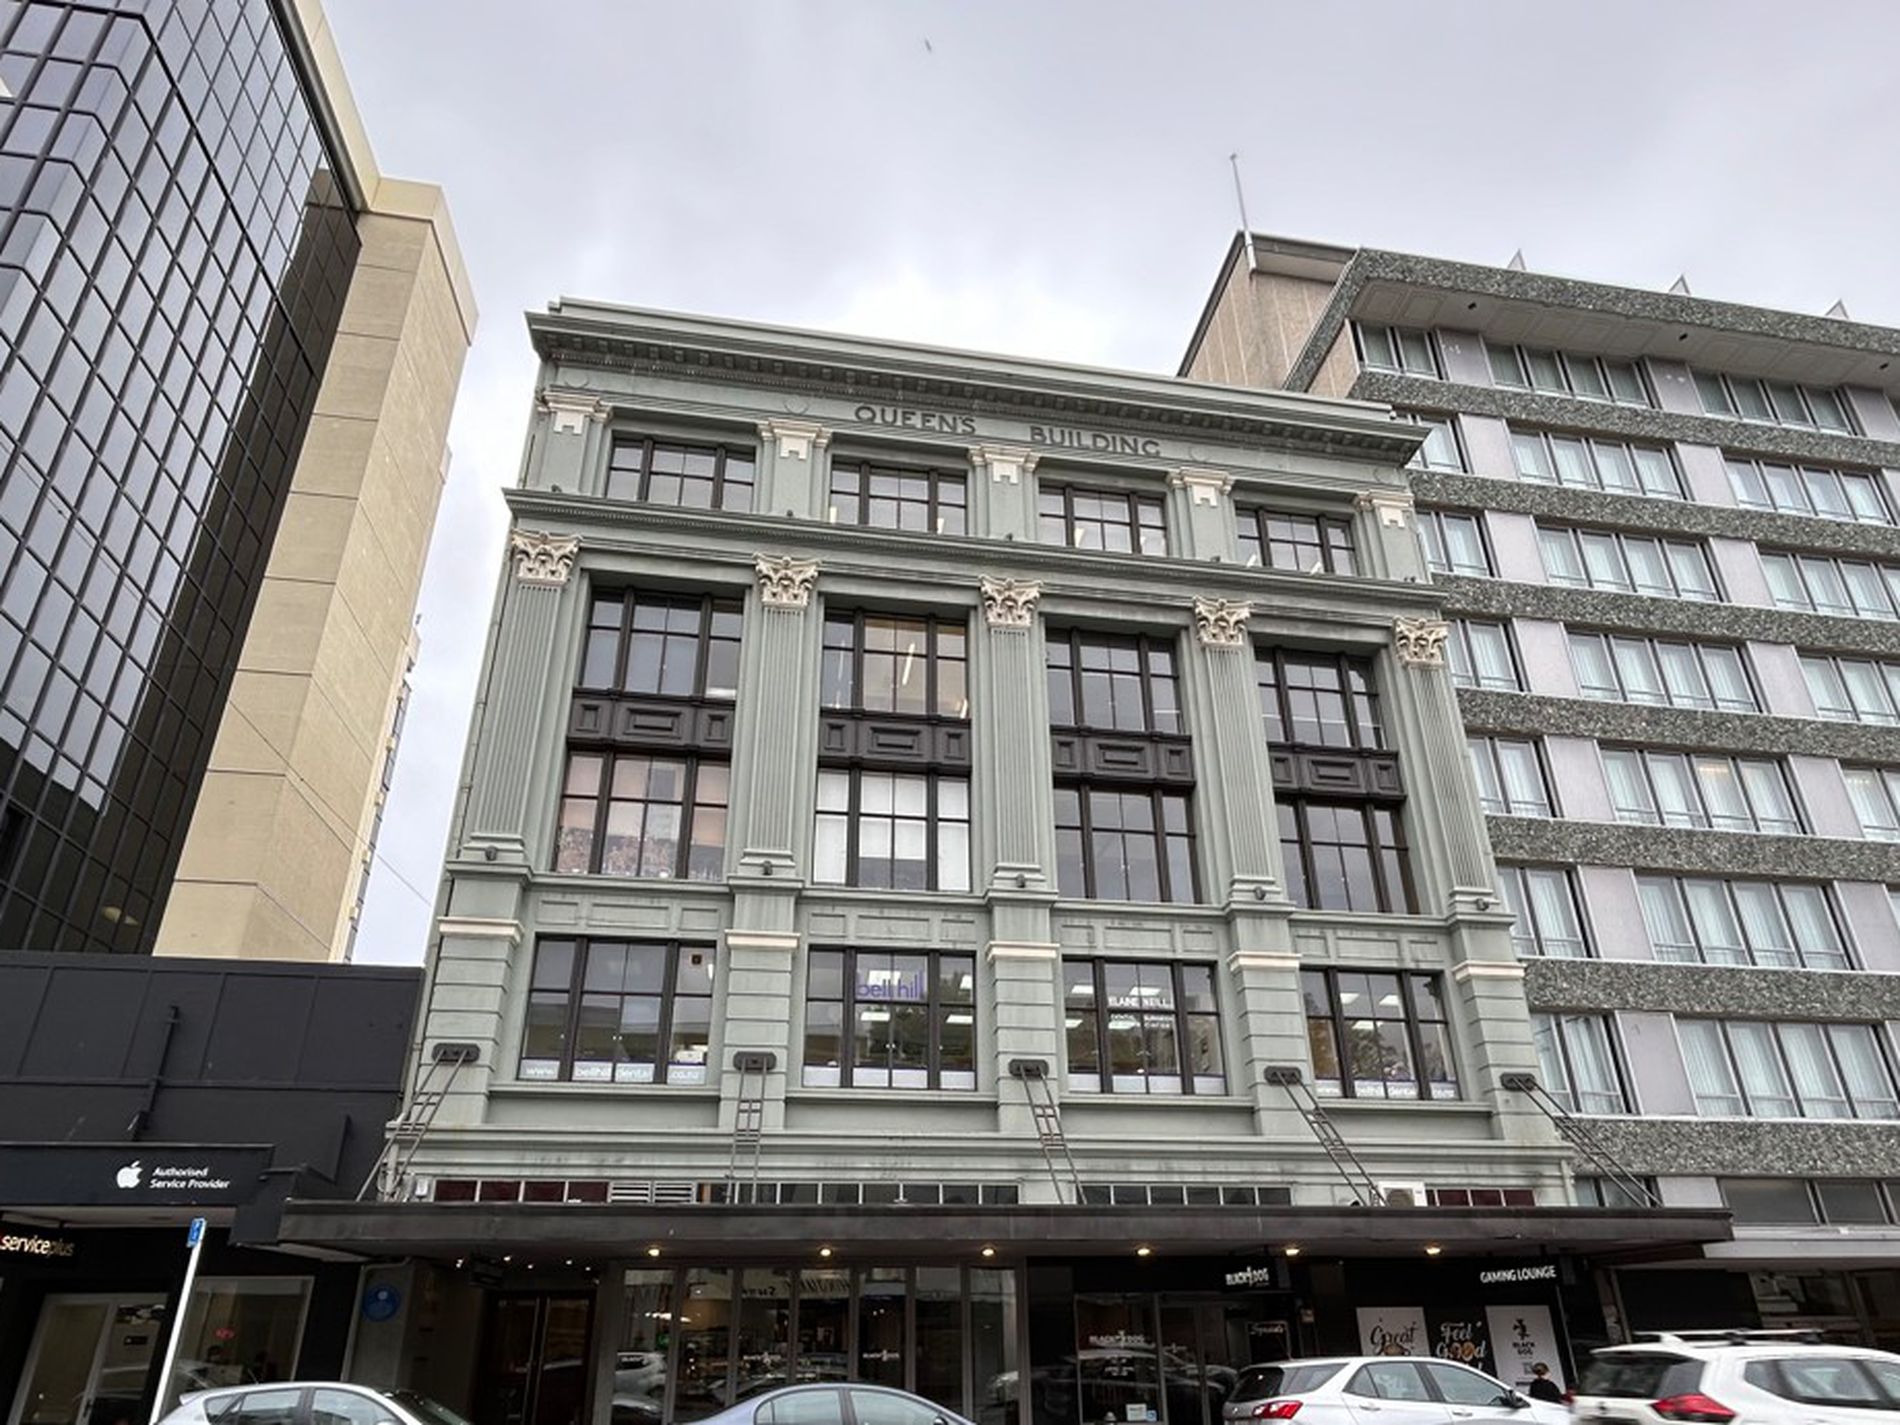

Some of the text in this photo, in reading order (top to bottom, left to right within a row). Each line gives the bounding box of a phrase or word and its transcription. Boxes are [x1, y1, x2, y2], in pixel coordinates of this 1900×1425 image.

[854, 404, 1161, 457] QUEEN'S BUILDING
[152, 1166, 209, 1177] Authorised
[149, 1178, 231, 1189] Service Provider
[1480, 1264, 1557, 1283] GAMING LOUNGE
[1370, 1324, 1418, 1356] Great
[1440, 1321, 1474, 1344] Feel
